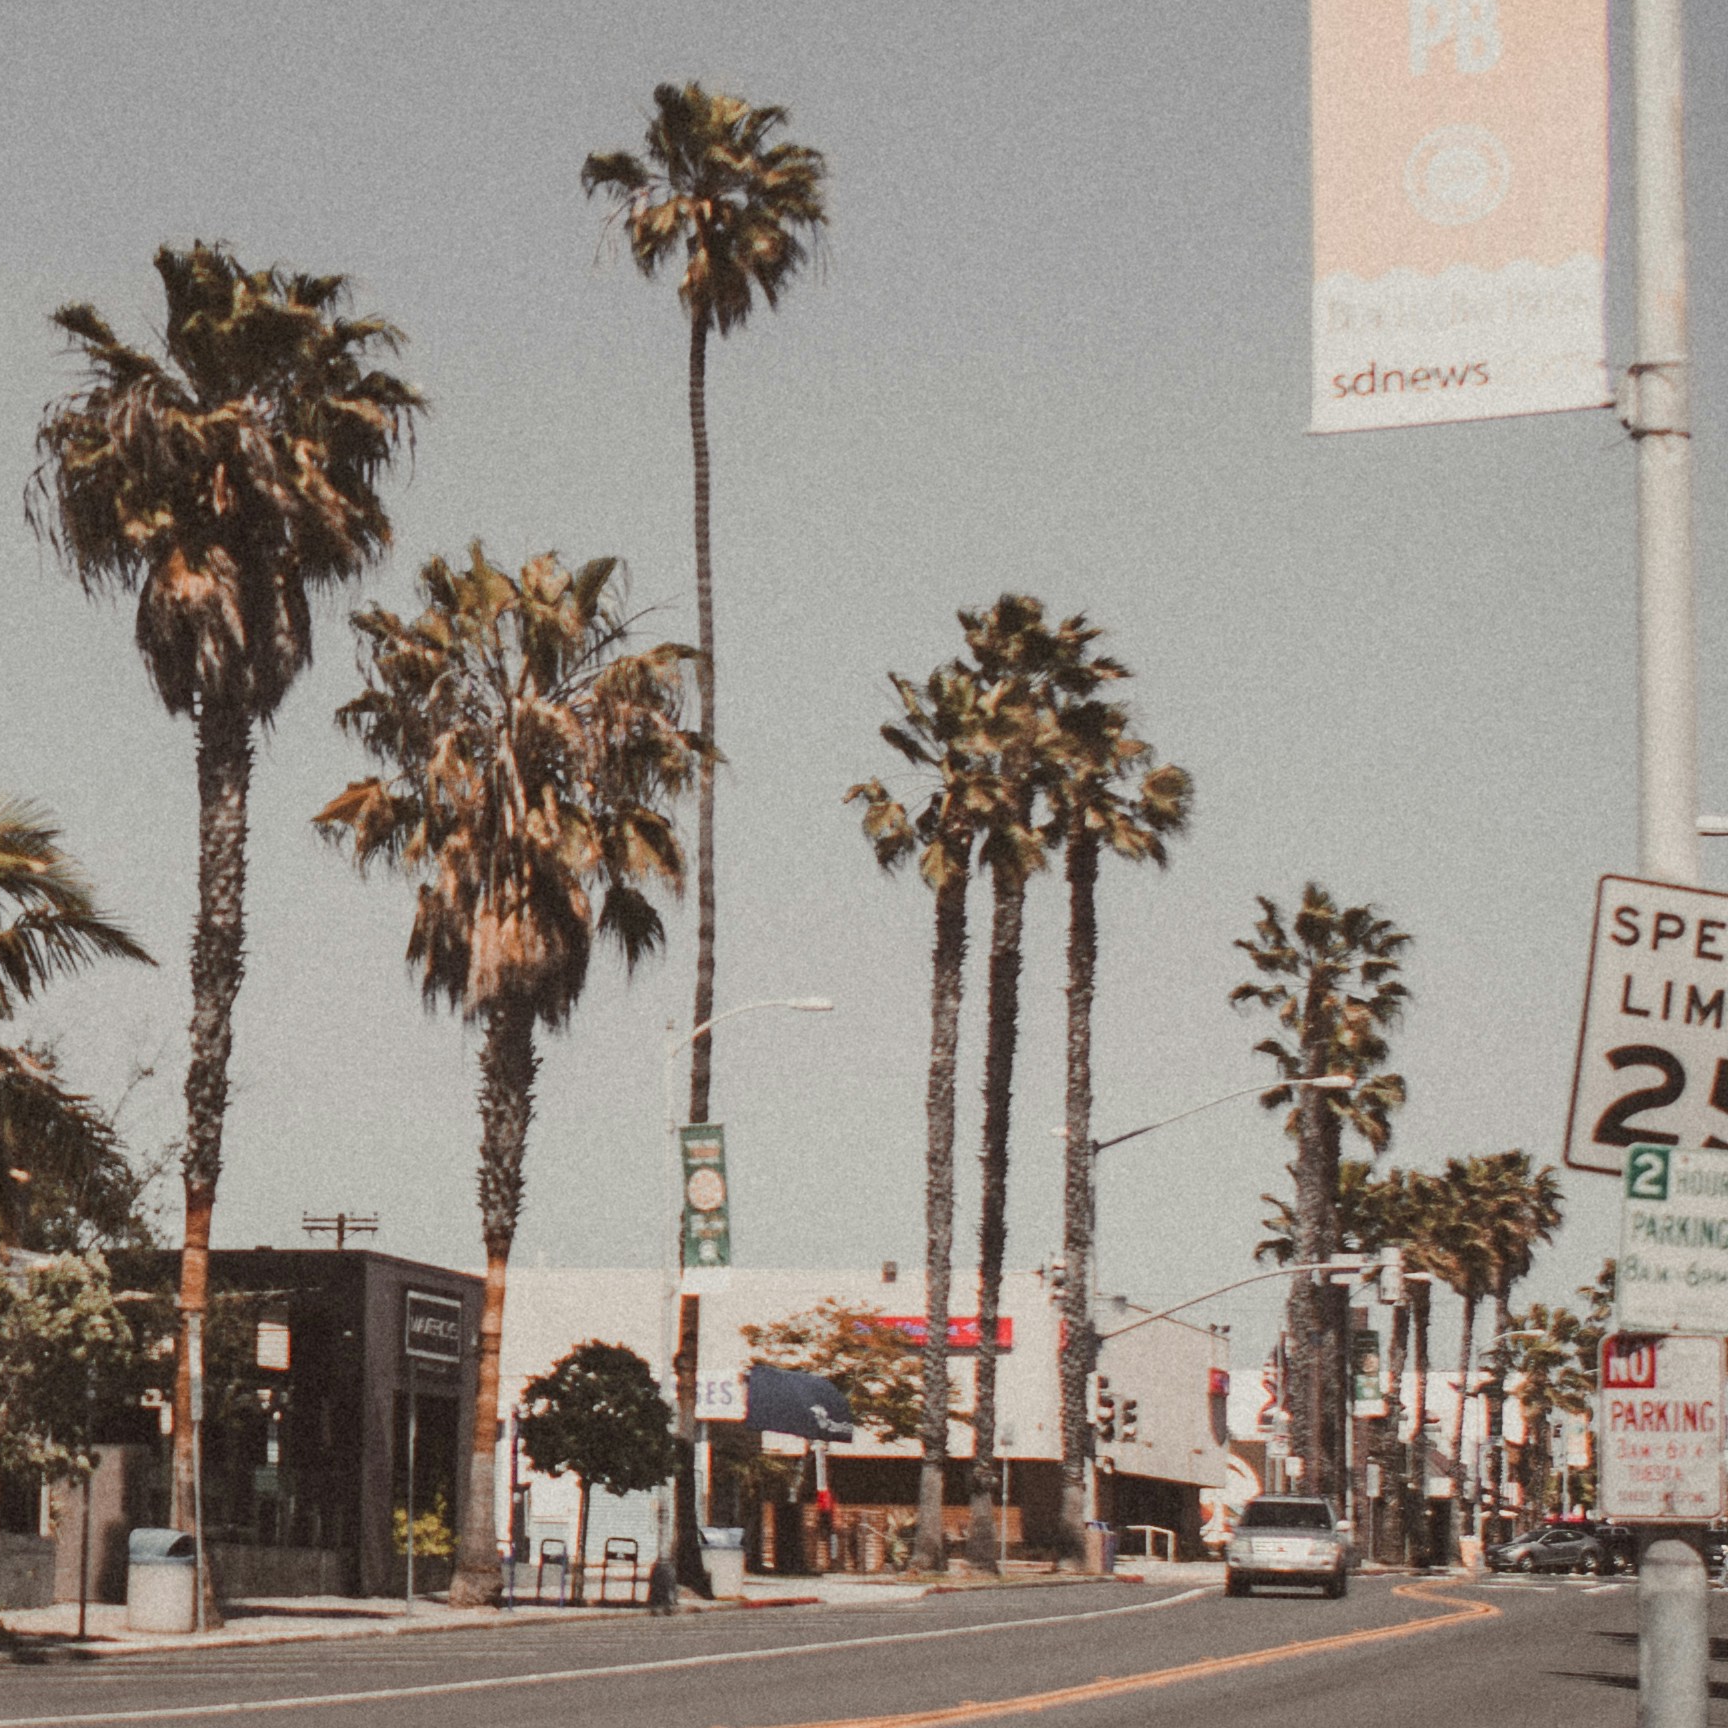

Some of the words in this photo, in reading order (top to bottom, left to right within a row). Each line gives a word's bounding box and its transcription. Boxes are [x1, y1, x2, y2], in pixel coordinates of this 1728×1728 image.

[1610, 904, 1727, 962] SPE
[1620, 974, 1726, 1029] LIM
[1632, 1152, 1664, 1195] 2
[1609, 1345, 1650, 1383] NO
[1610, 1399, 1716, 1432] PARKING
